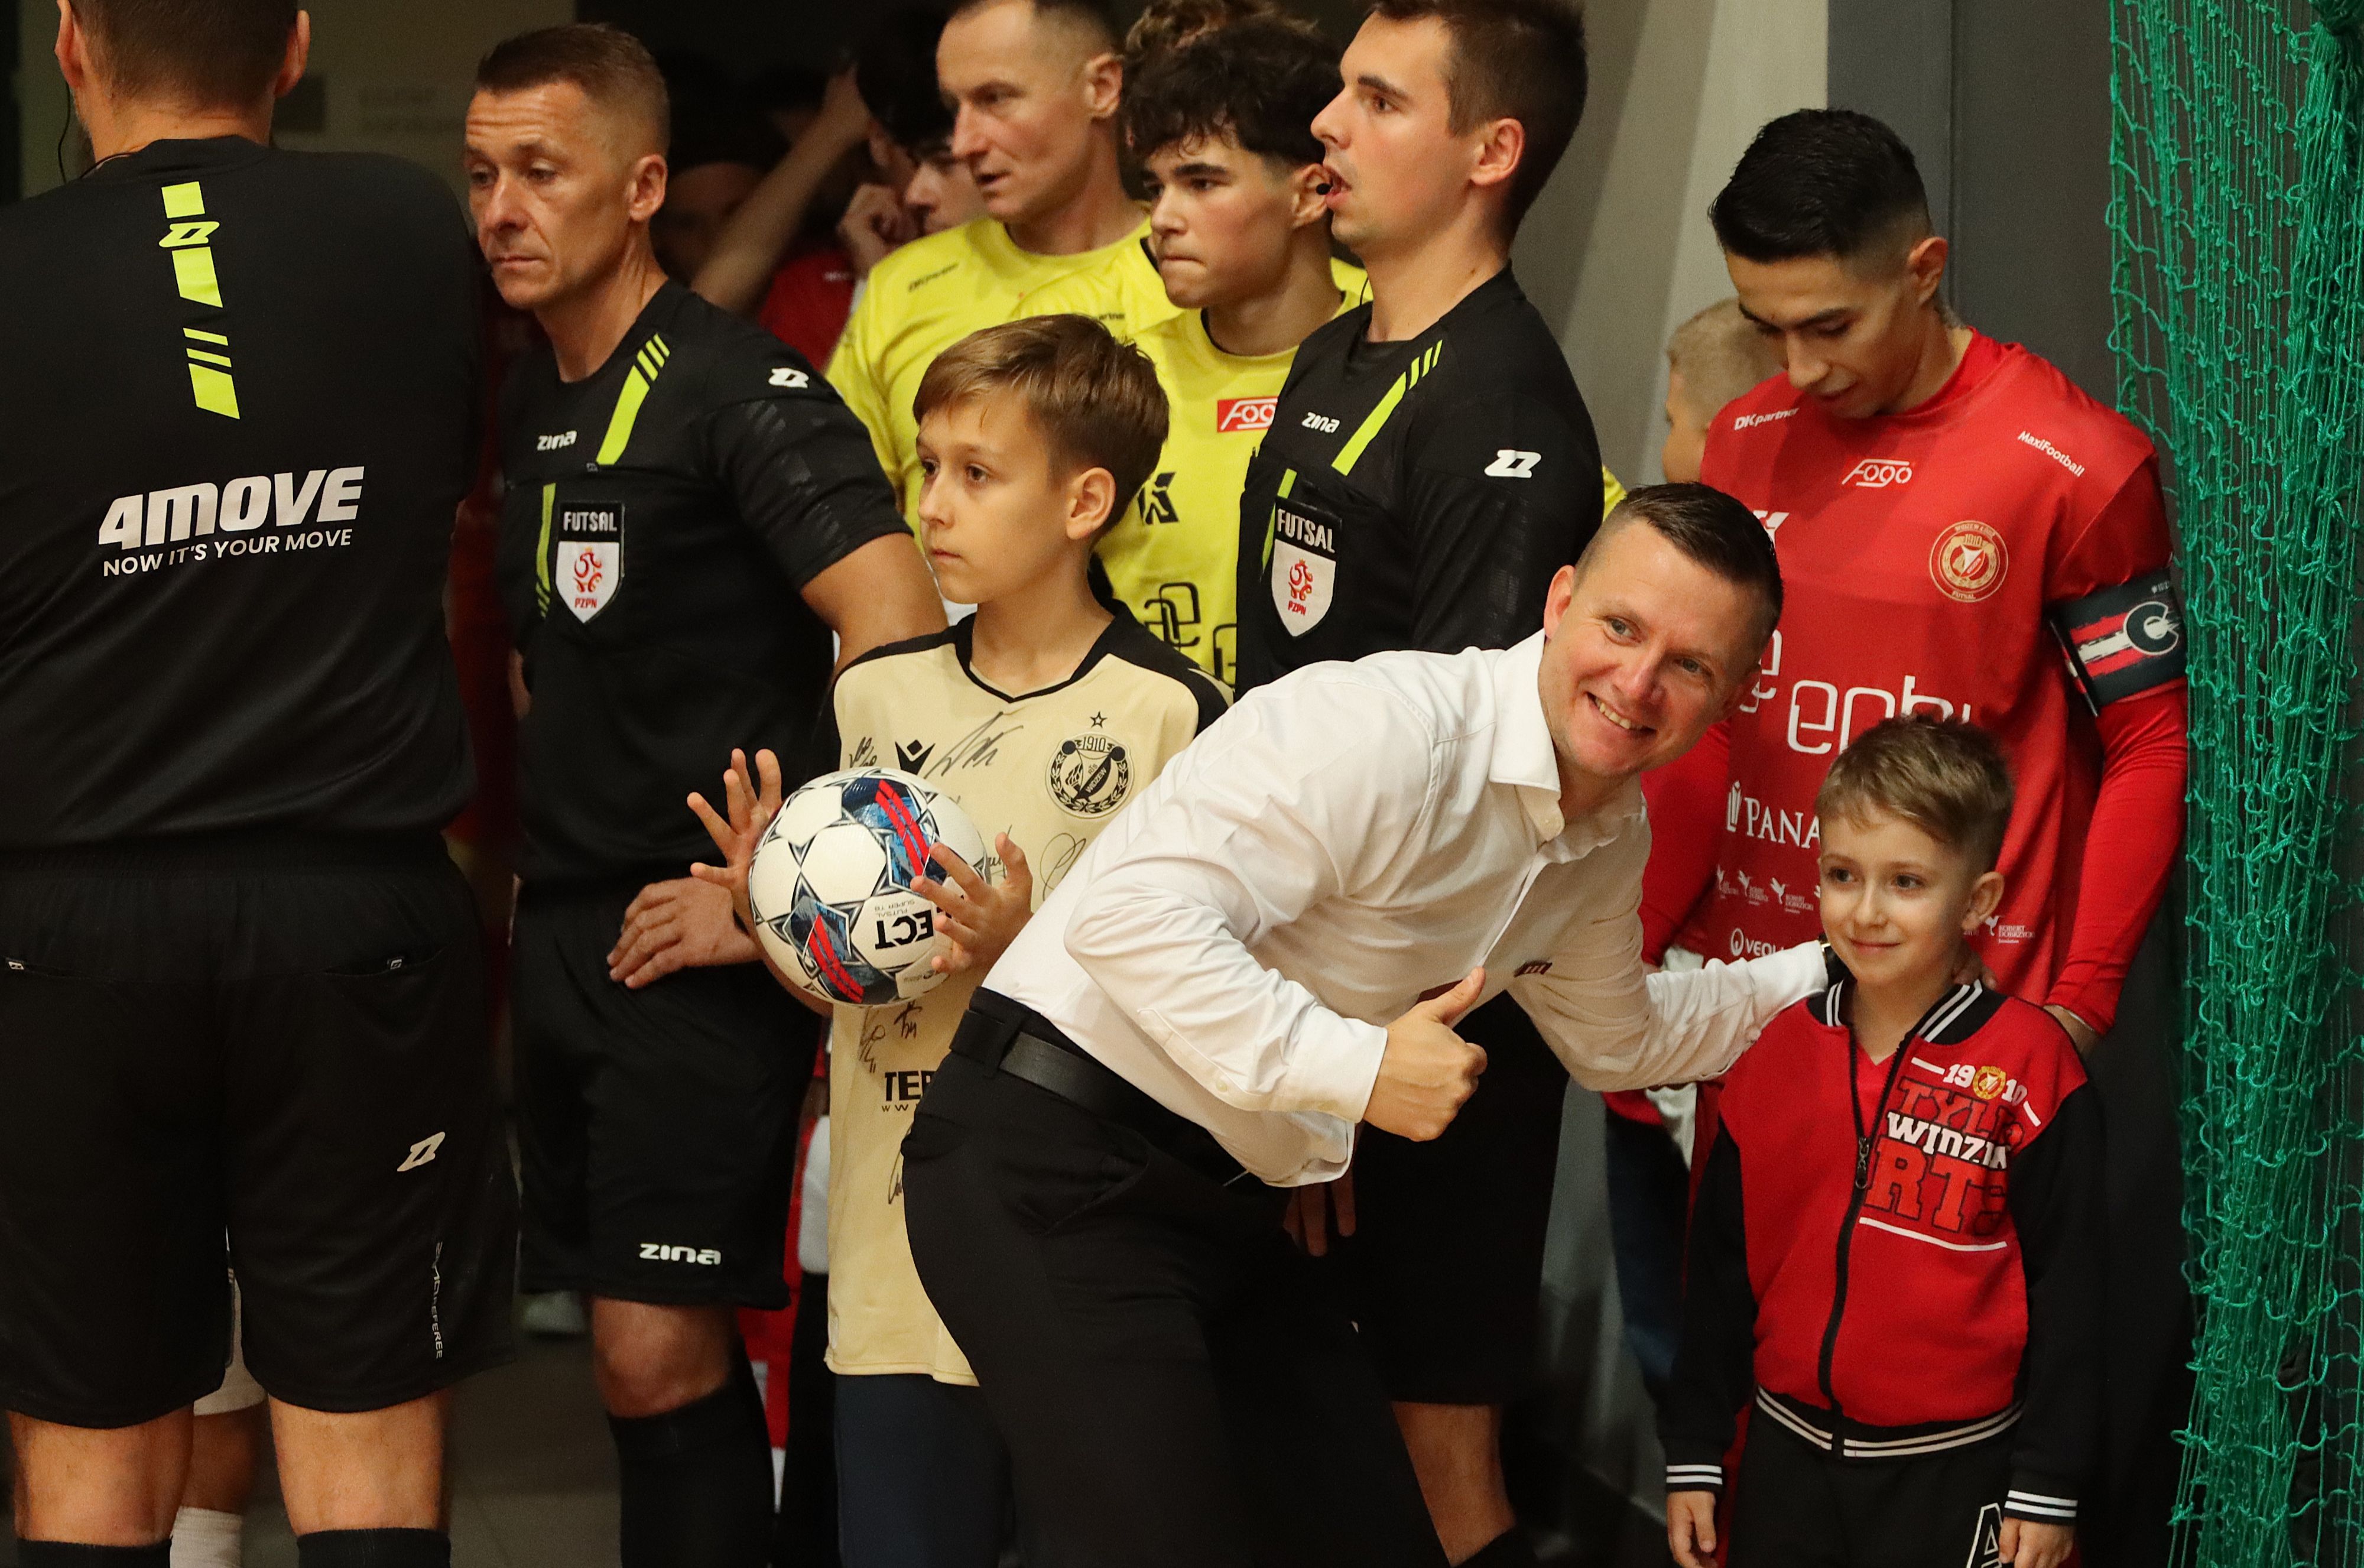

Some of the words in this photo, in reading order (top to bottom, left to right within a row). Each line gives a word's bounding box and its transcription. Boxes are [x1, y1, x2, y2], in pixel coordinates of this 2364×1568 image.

[1220, 398, 1278, 430] Fog
[2017, 430, 2085, 477] MaxiFootball
[1842, 459, 1913, 488] Fogo
[98, 466, 365, 550] 4MOVE
[563, 511, 618, 531] FUTSAL
[1277, 508, 1335, 554] FUTSAL
[103, 553, 164, 577] NOW
[168, 543, 207, 566] IT'S
[214, 535, 280, 559] YOUR
[285, 529, 353, 551] MOVE
[574, 598, 598, 609] PZPN
[1288, 600, 1306, 615] PZPN
[1083, 736, 1106, 752] 1910
[1085, 767, 1107, 793] WIDZEW
[1745, 797, 1821, 848] PANA
[876, 908, 908, 918] FUTSAL
[875, 910, 934, 950] ECT
[1746, 938, 1784, 956] VEO
[1943, 1064, 1976, 1088] 19
[2001, 1079, 2027, 1106] 10
